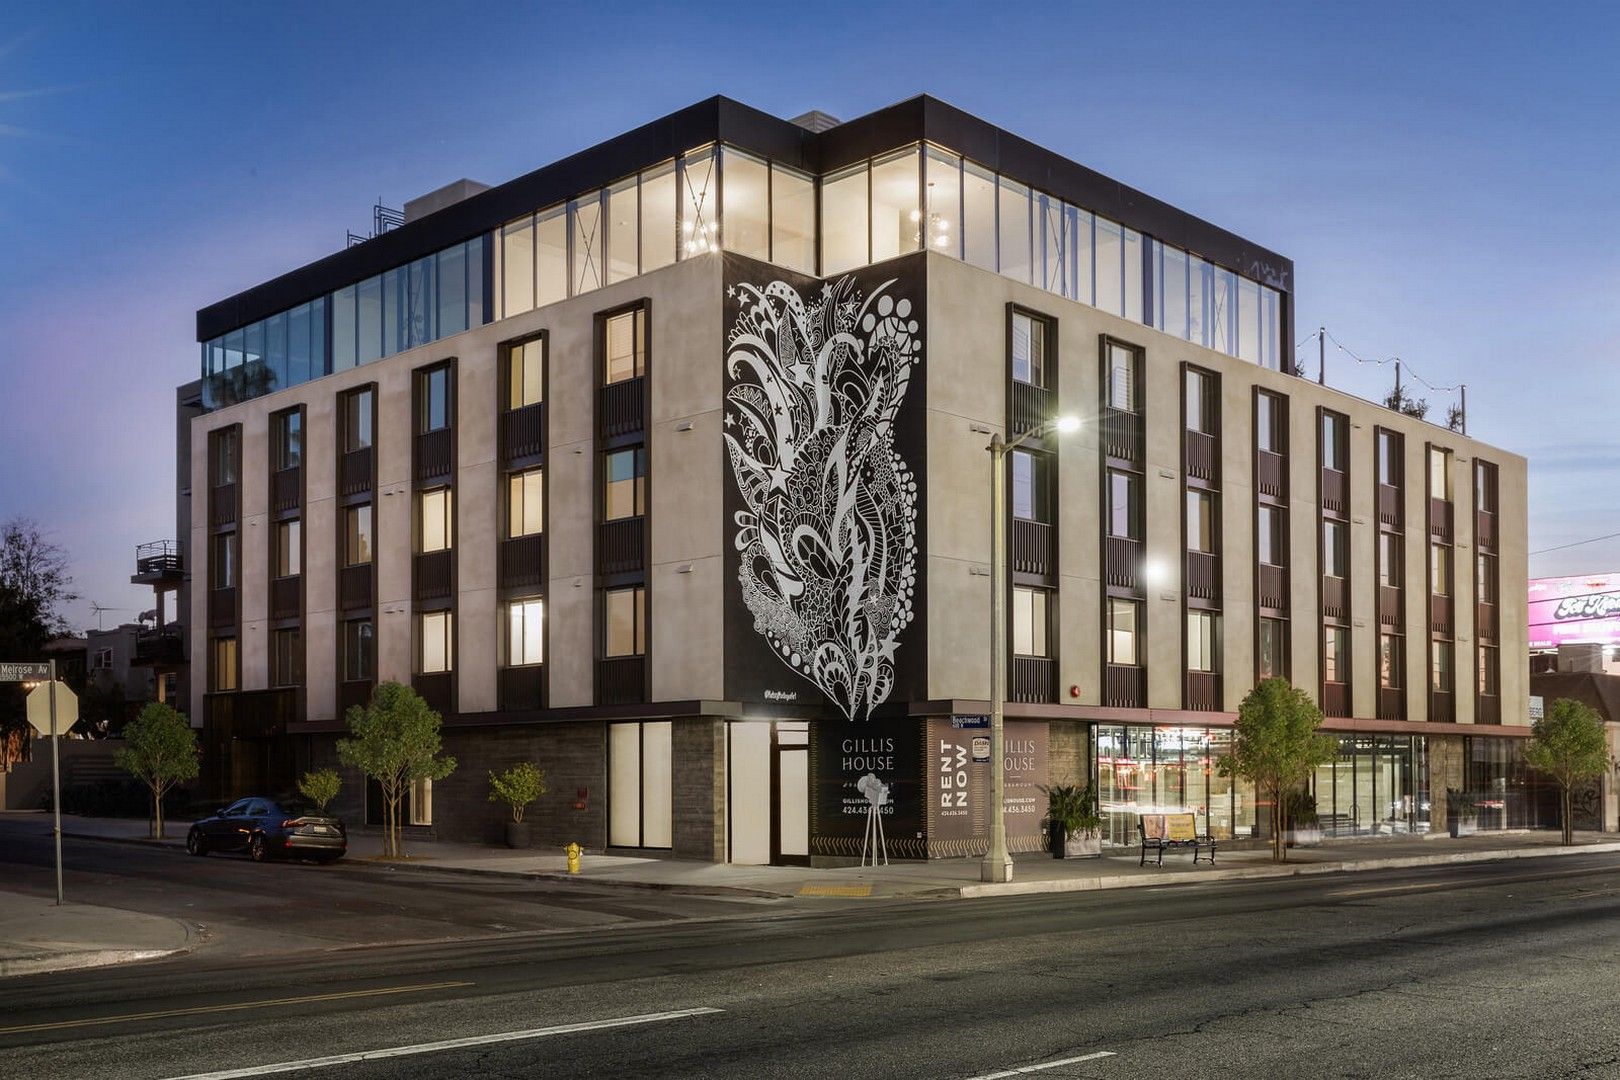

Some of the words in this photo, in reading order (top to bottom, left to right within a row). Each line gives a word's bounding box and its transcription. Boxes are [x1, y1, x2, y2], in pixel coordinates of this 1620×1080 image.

[1, 665, 33, 674] Melrose
[38, 665, 48, 674] Av
[842, 738, 894, 753] GILLIS
[1005, 740, 1036, 754] ILLIS
[842, 756, 894, 771] HOUSE
[1004, 757, 1036, 771] OUSE
[941, 739, 953, 808] RENT
[956, 744, 968, 807] NOW
[1003, 805, 1036, 814] 4.436.3450
